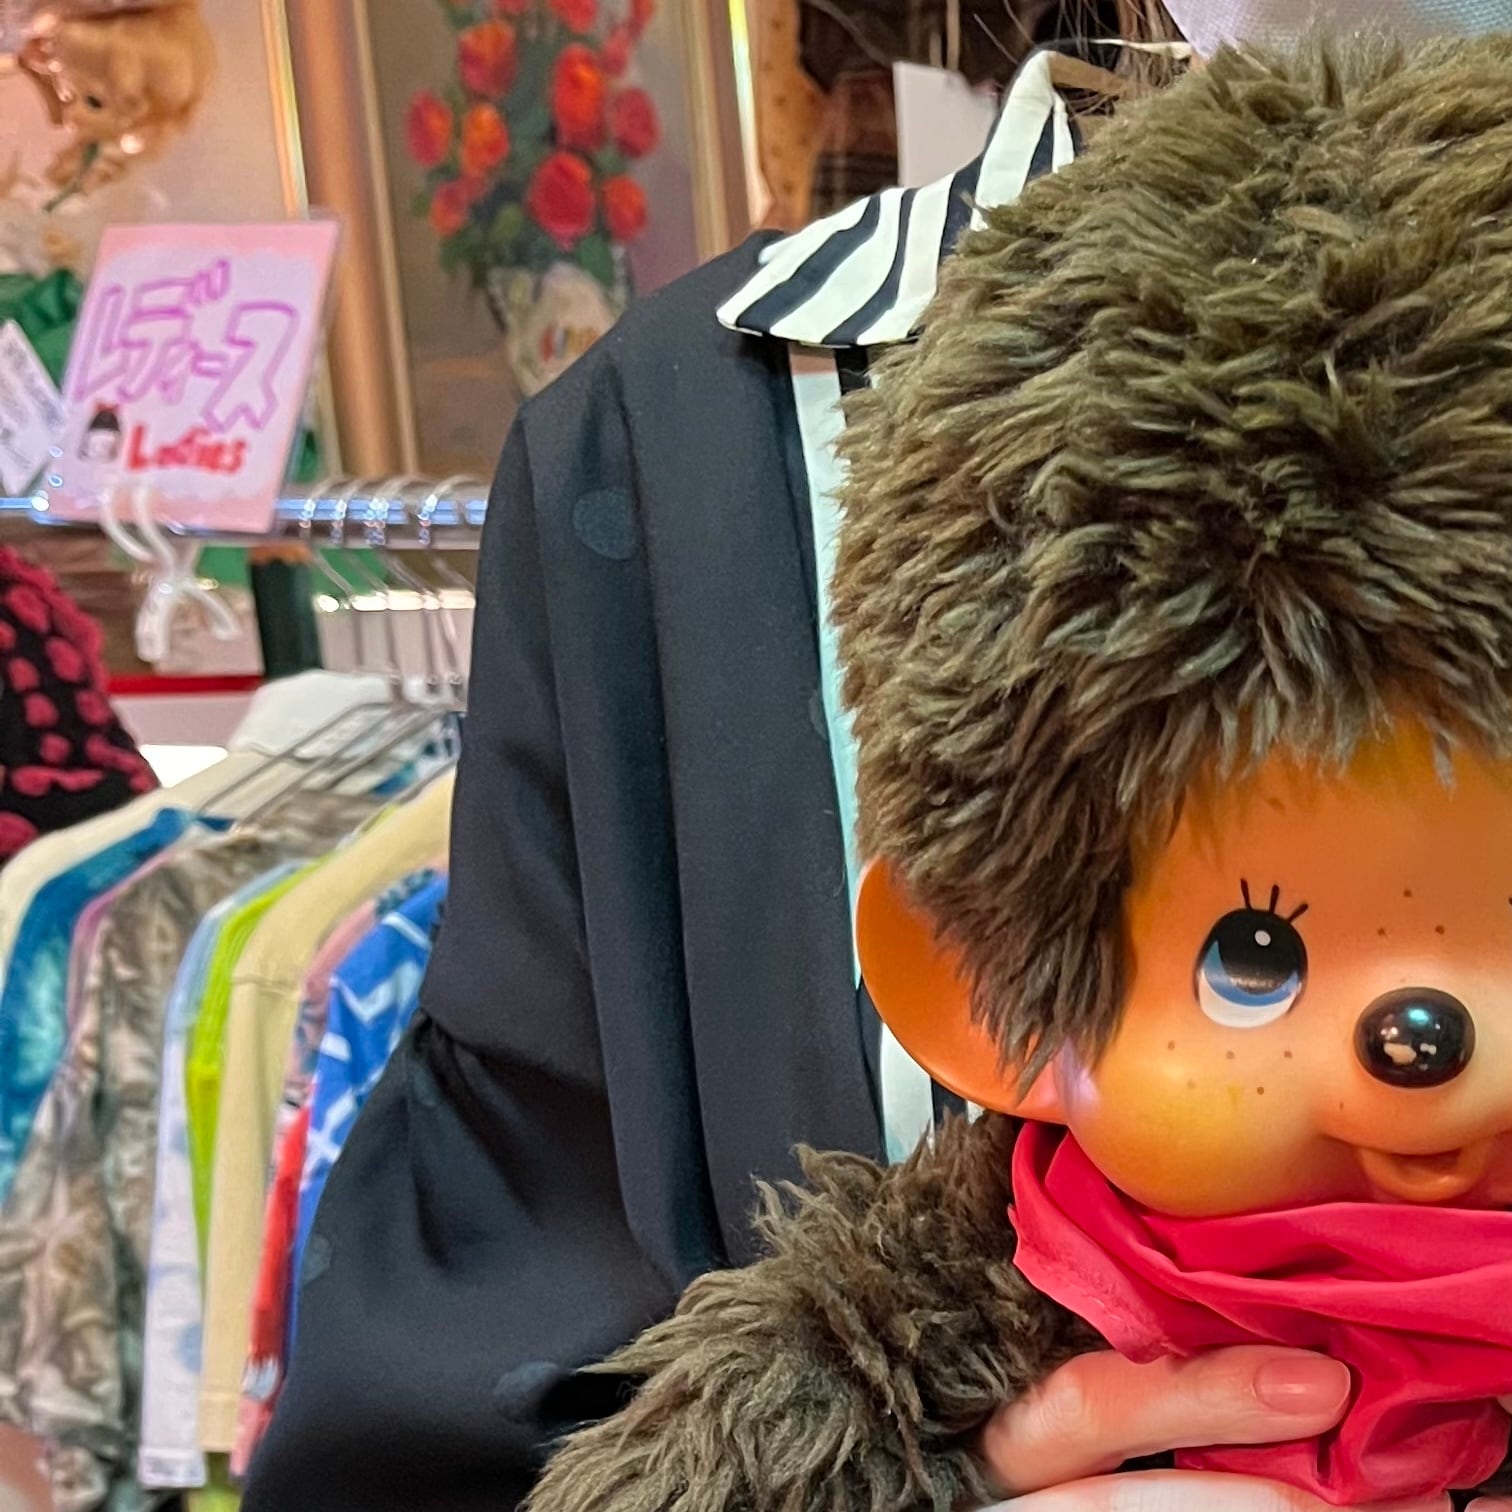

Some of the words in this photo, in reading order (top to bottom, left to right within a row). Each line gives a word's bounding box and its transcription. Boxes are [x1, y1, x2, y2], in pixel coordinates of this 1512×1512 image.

[73, 258, 299, 432] レディース
